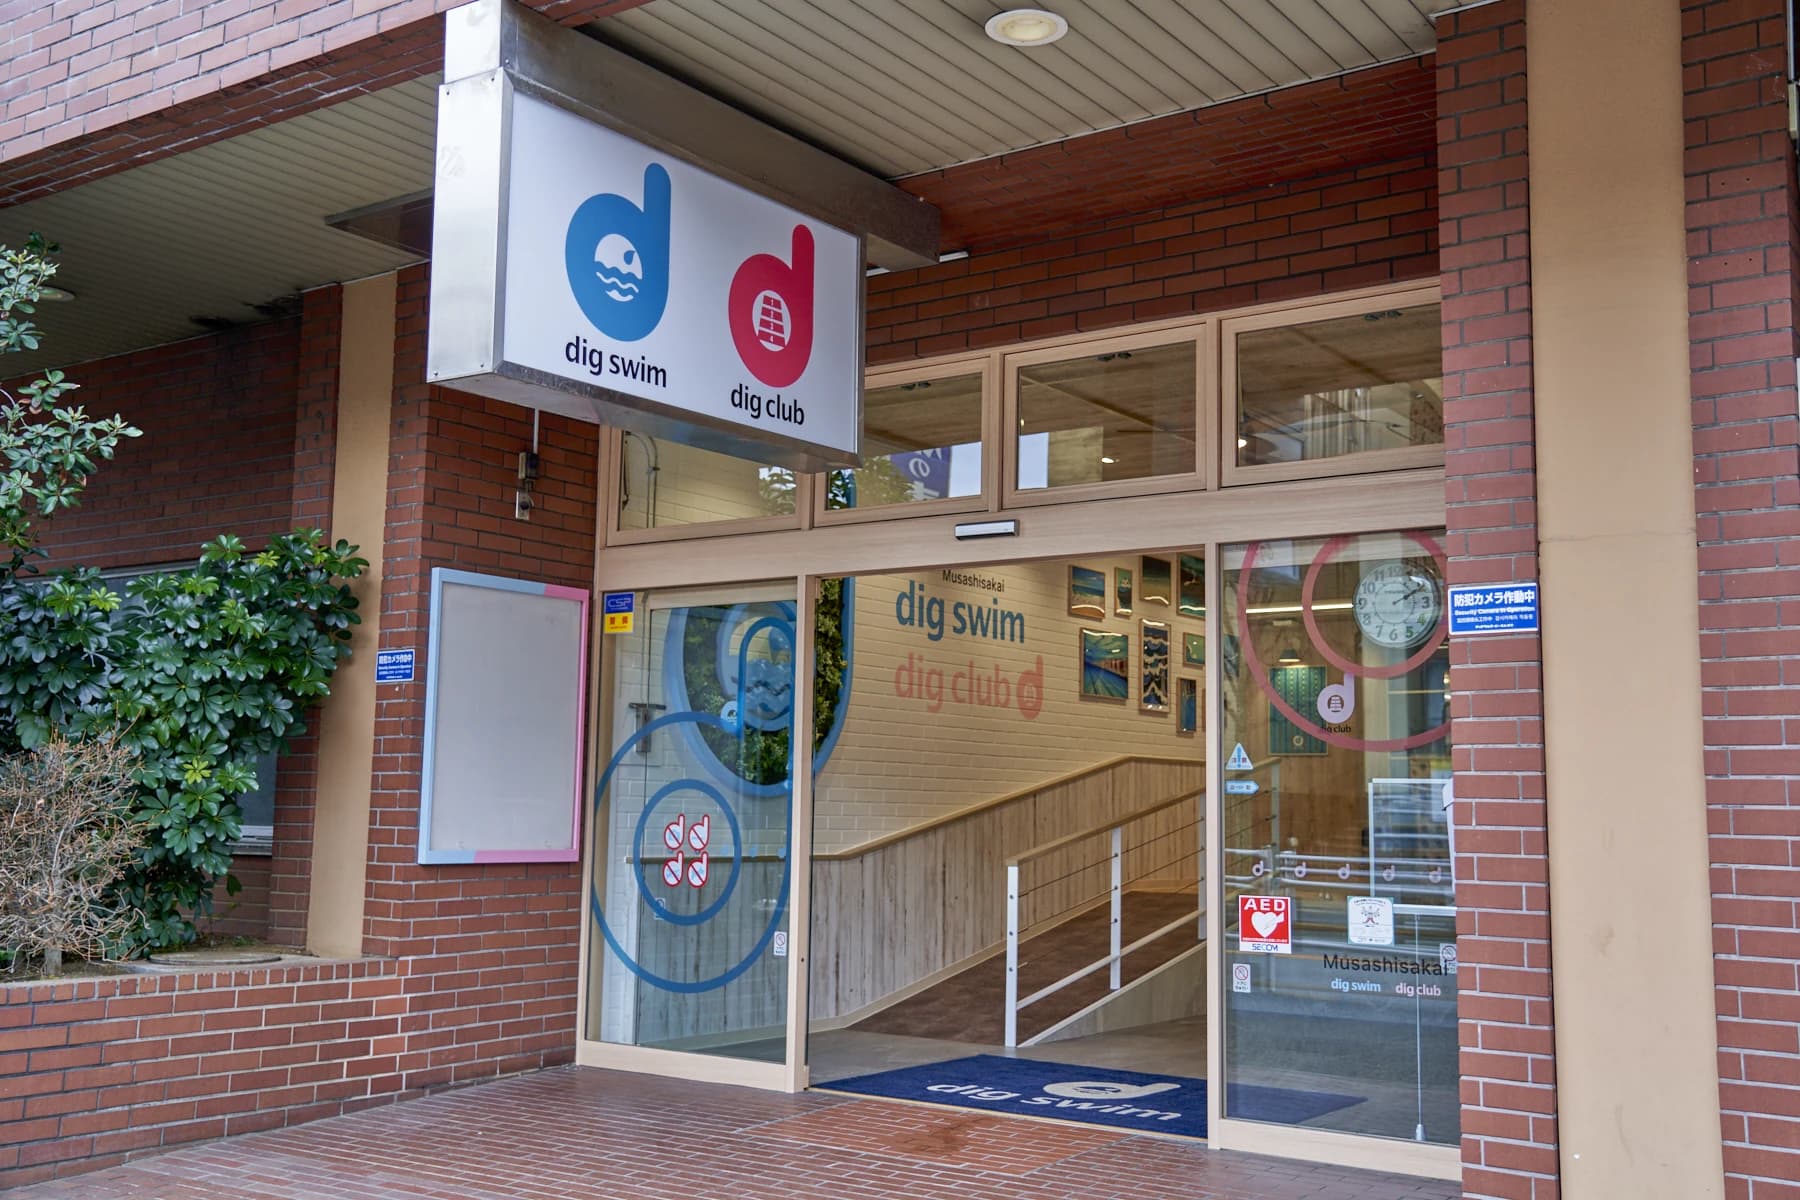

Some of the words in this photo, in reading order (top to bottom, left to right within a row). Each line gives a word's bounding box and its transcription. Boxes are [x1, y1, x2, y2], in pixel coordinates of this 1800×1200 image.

[565, 335, 603, 376] dig
[609, 355, 667, 388] swim
[731, 383, 761, 419] dig
[766, 394, 804, 425] club
[942, 569, 1005, 592] Musashisakai
[607, 597, 632, 608] CSP
[1453, 590, 1535, 607] 防犯カメラ作動中
[896, 579, 945, 641] dig
[953, 597, 1025, 644] swim
[895, 652, 944, 714] dig
[952, 660, 1010, 708] club
[1244, 898, 1286, 911] AED
[1252, 943, 1278, 951] SECOM
[1323, 954, 1448, 976] Musashisakai
[1331, 978, 1349, 992] dig
[1351, 980, 1381, 992] swim
[1395, 983, 1414, 997] dig
[1416, 984, 1441, 996] club
[926, 1083, 1021, 1101] dig
[1020, 1096, 1182, 1121] swim
